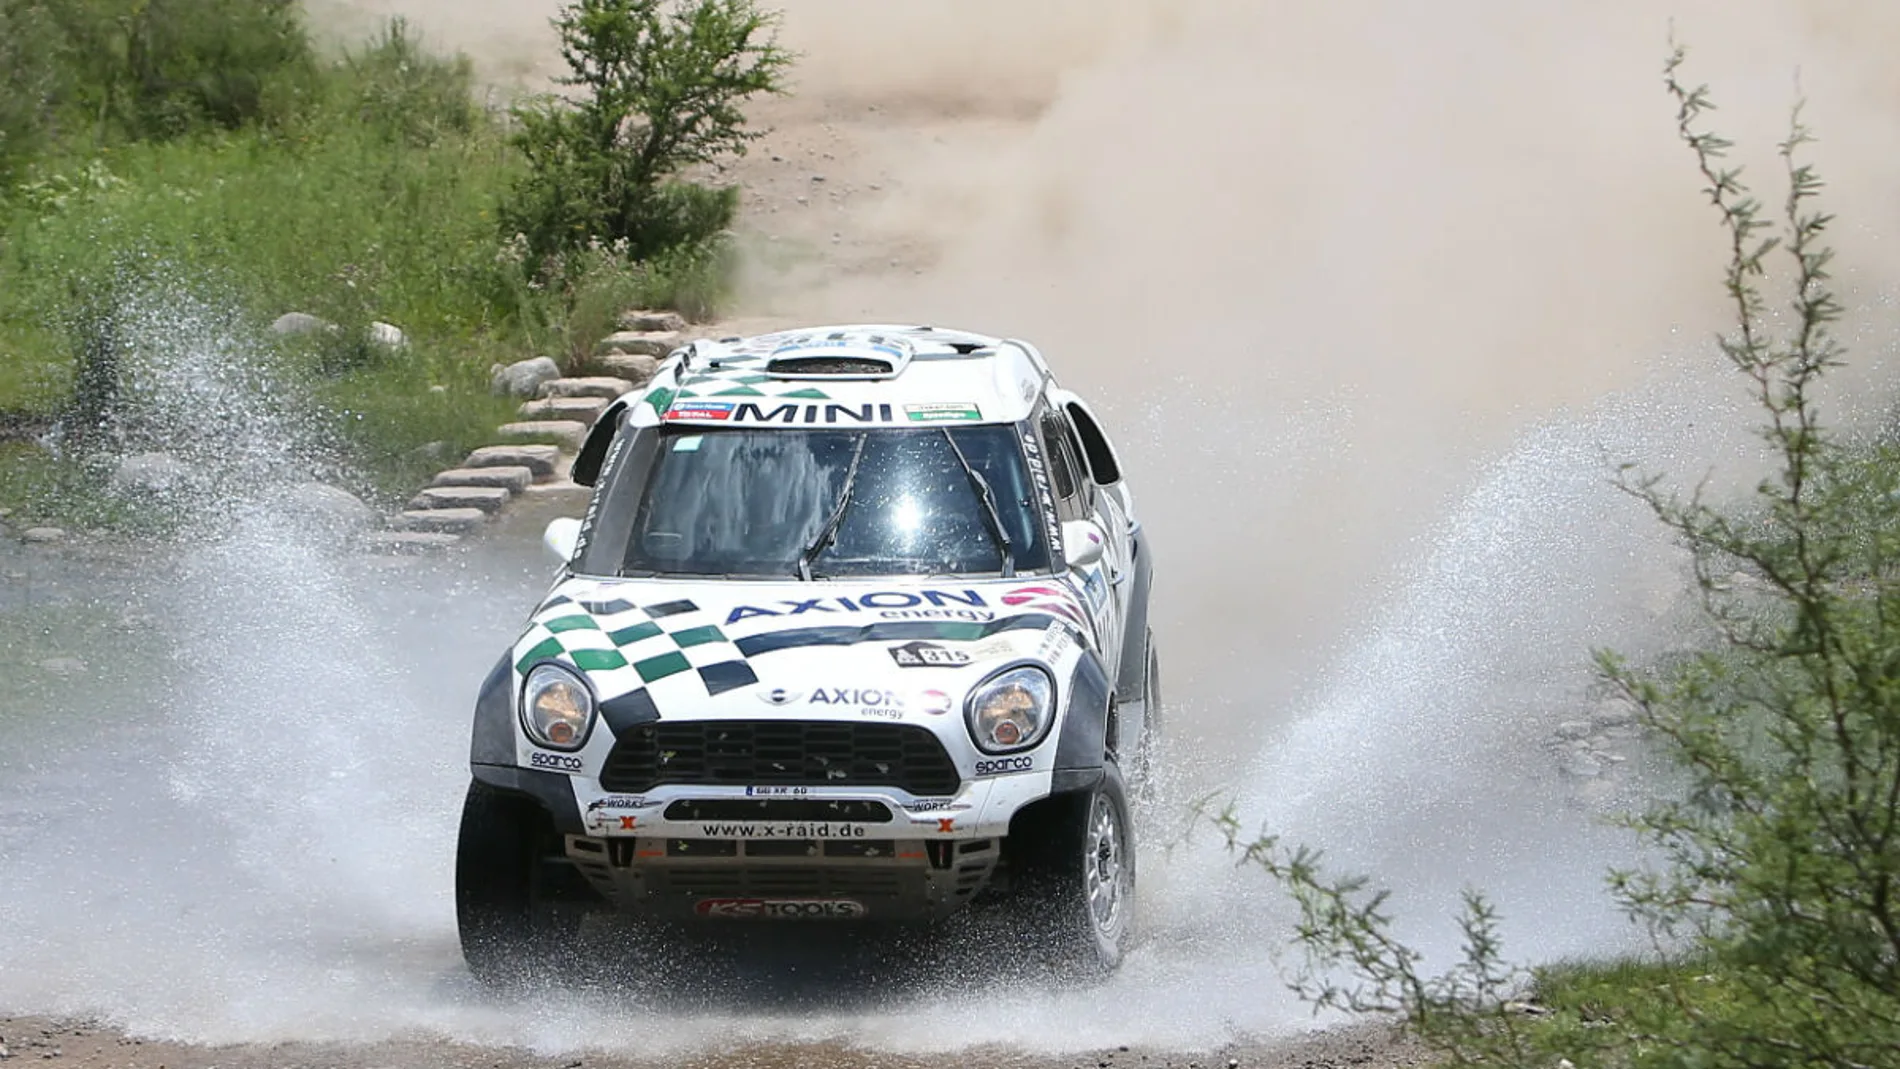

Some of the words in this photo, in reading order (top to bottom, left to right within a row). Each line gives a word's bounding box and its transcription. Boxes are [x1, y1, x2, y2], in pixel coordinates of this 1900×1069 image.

[734, 403, 894, 422] MINI
[724, 589, 989, 625] AXION
[880, 608, 995, 621] energy
[924, 650, 971, 662] 315
[809, 688, 904, 706] AXION
[861, 707, 904, 718] energy
[531, 752, 582, 770] sparco
[975, 756, 1033, 773] sparco
[607, 798, 645, 809] WORKS
[913, 801, 951, 812] WORKS
[703, 822, 865, 838] www.x-raid.de
